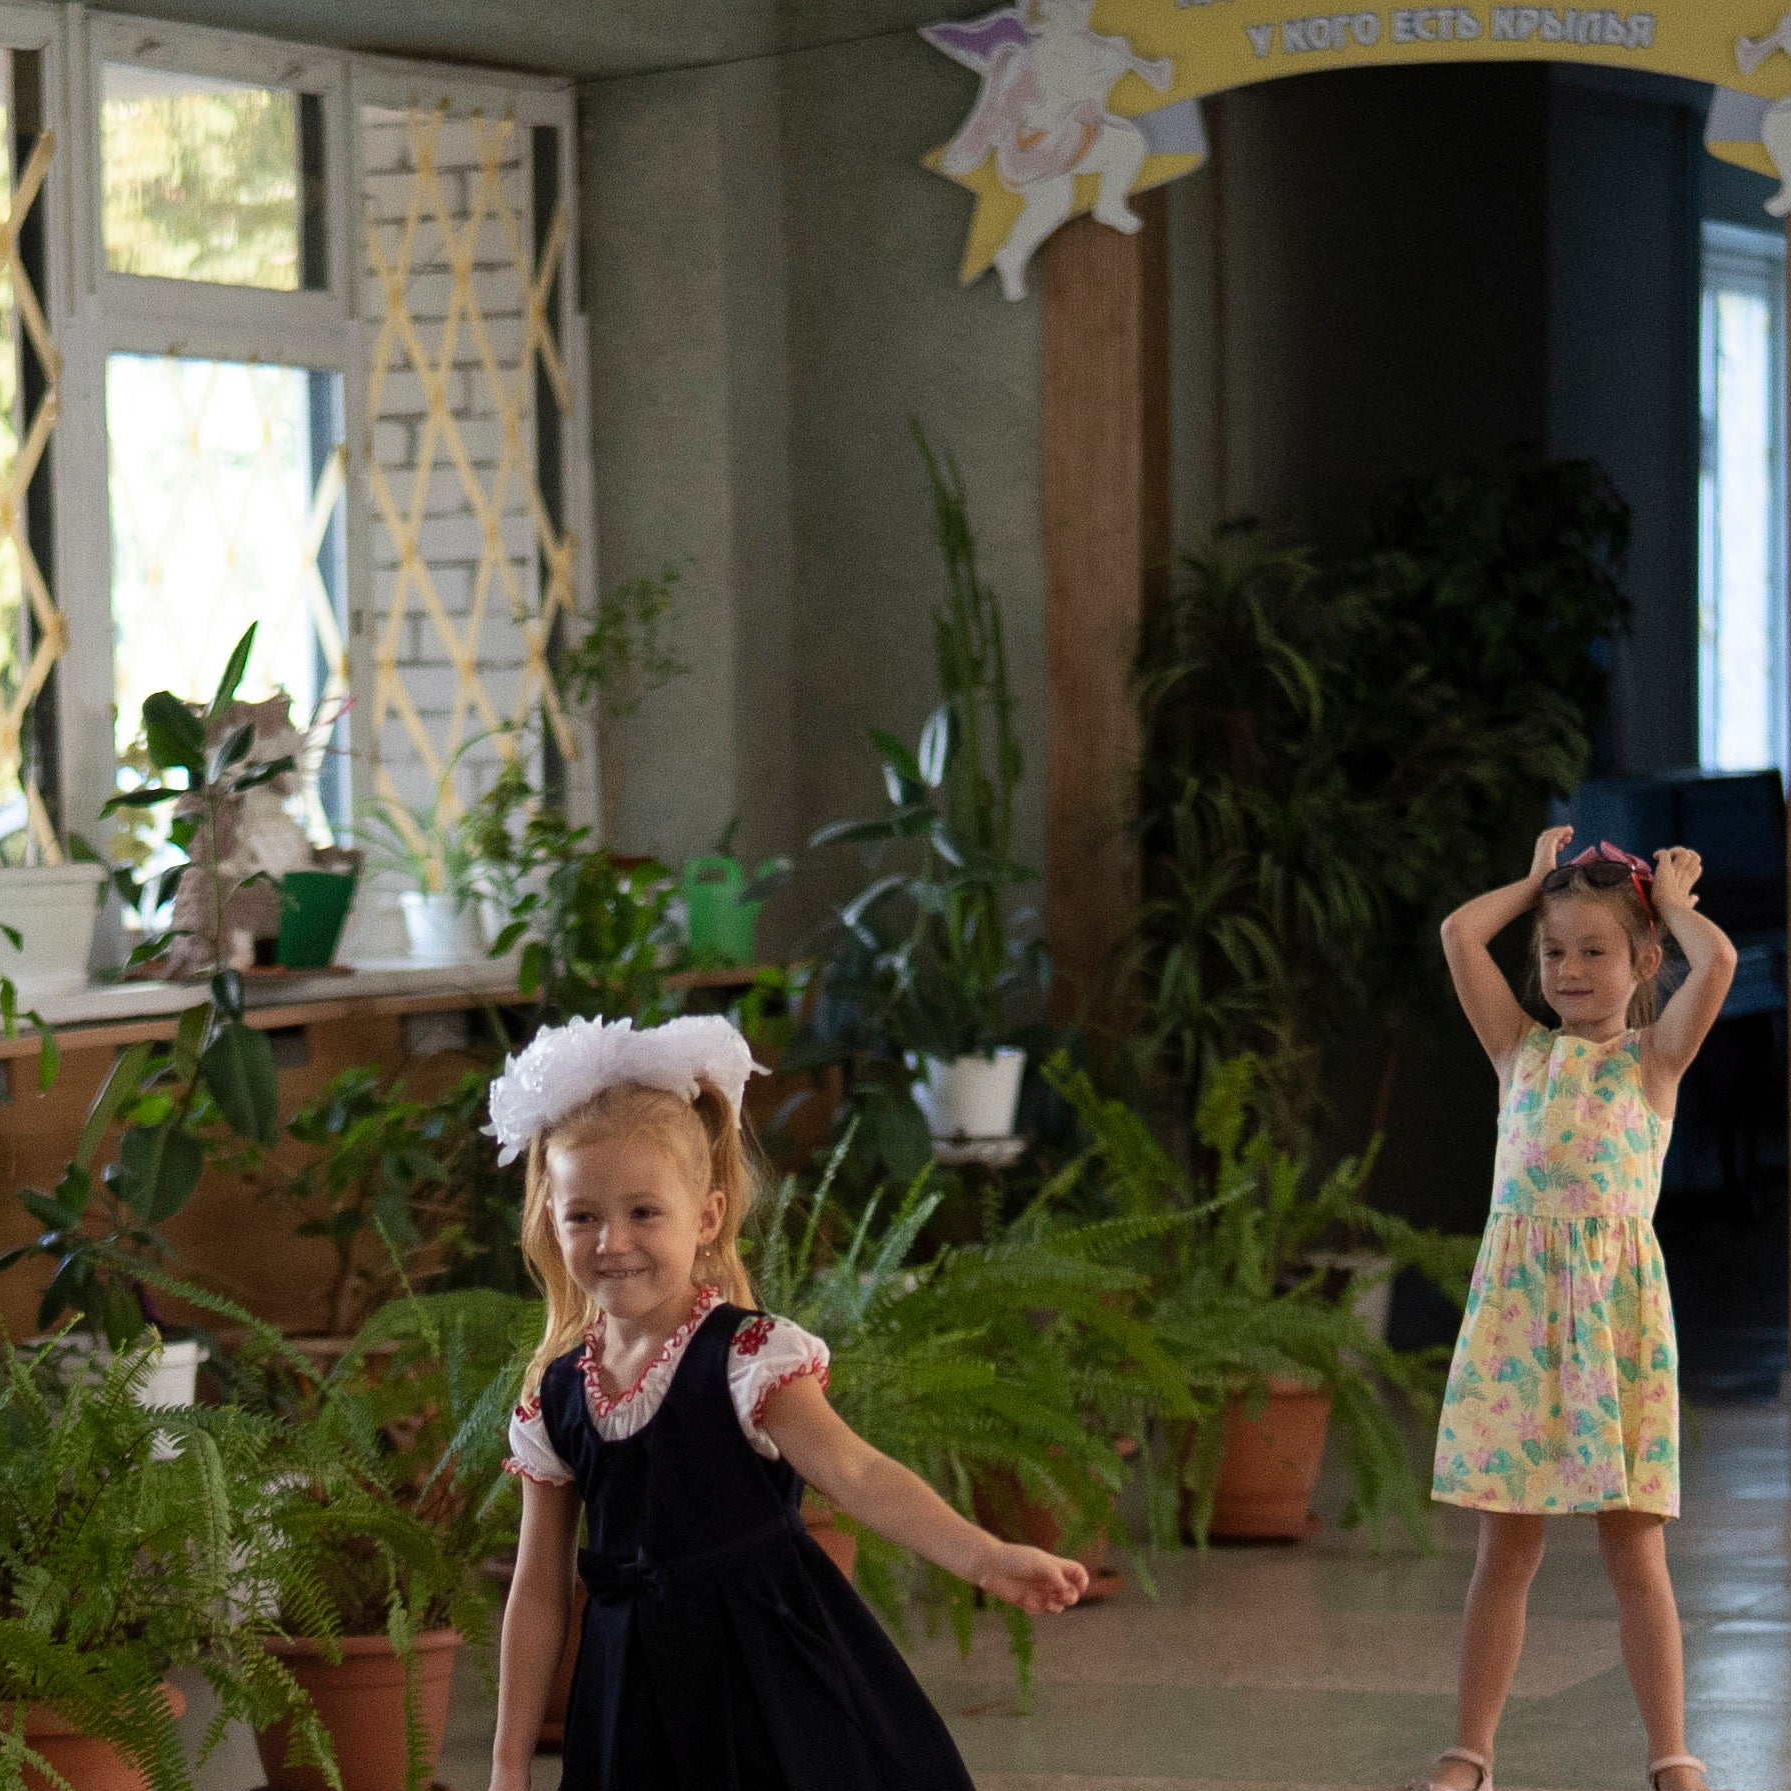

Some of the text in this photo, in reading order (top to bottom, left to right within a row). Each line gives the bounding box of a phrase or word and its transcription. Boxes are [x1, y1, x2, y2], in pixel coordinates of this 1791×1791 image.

[1246, 7, 1655, 58] У КОГО ЕСТЬ КРЫЛЬЯ
